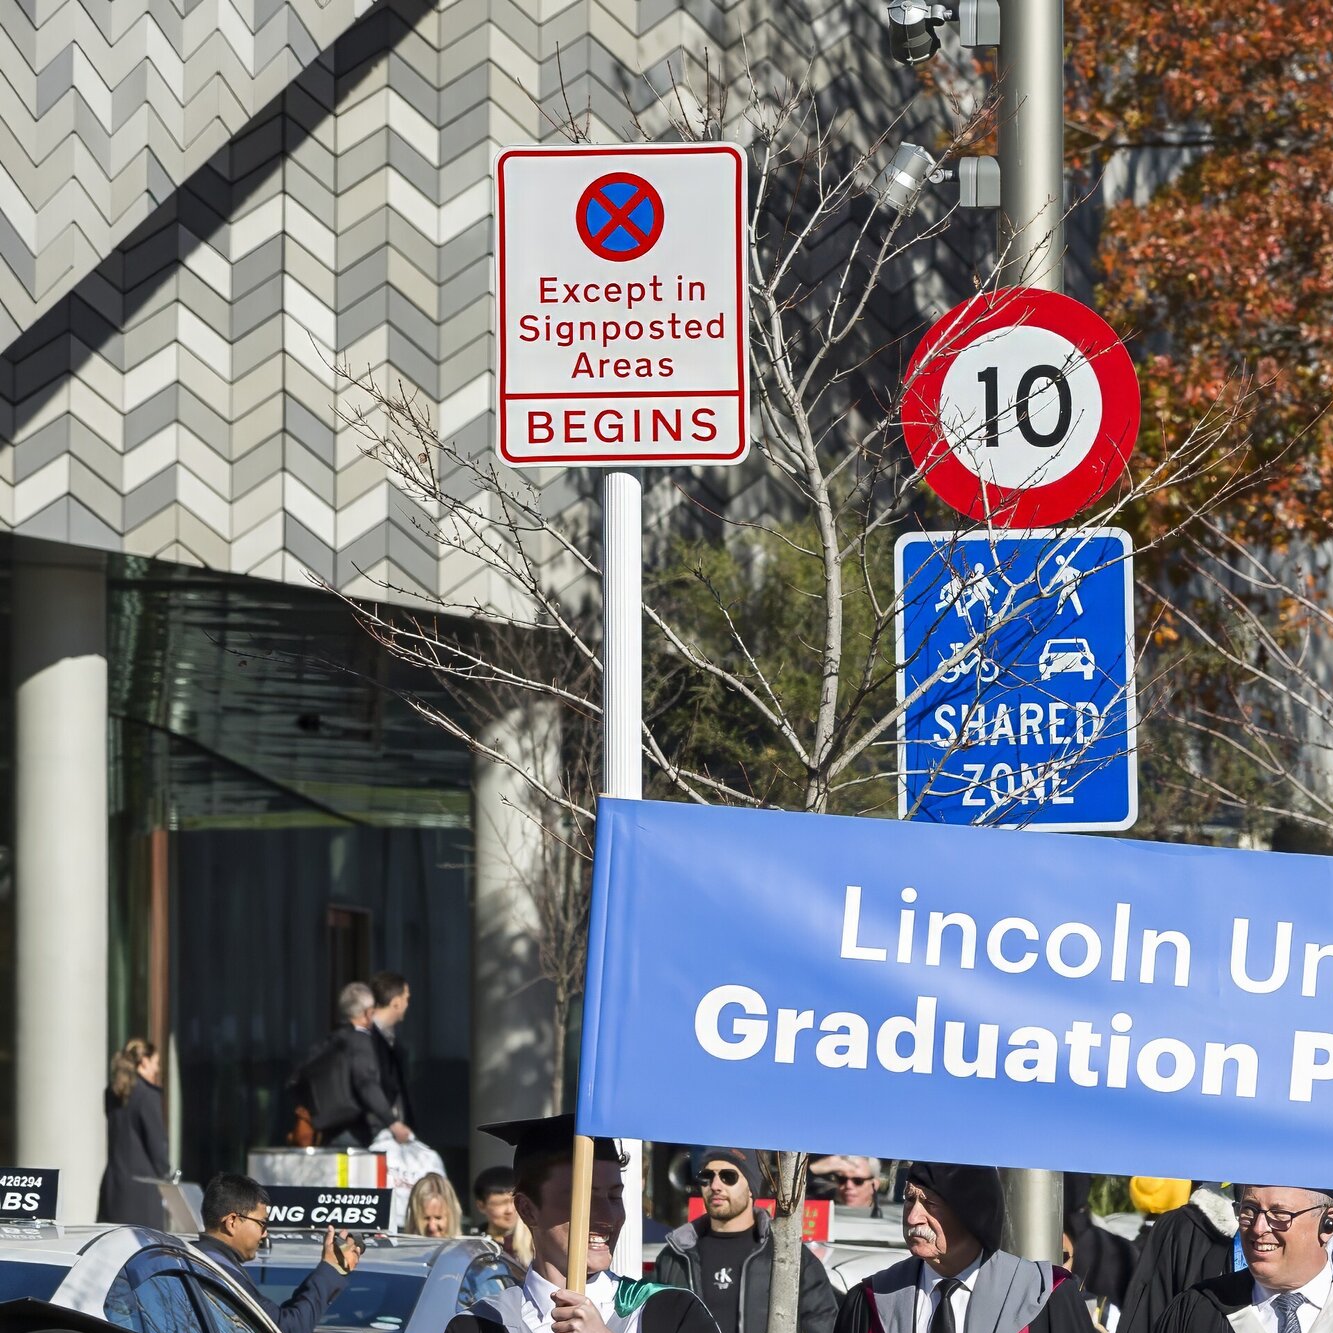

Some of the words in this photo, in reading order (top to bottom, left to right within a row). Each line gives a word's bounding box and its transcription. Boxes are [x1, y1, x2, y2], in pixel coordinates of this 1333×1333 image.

[539, 275, 663, 309] Except
[676, 275, 706, 301] in
[519, 313, 725, 347] Signposted
[571, 351, 674, 379] Areas
[976, 365, 1072, 447] 10
[527, 408, 718, 444] BEGINS
[932, 701, 1099, 747] SHARED
[962, 763, 1075, 806] ZONE
[840, 885, 1191, 987] Lincoln
[694, 984, 1259, 1098] Graduation
[311, 1207, 377, 1224] CABS
